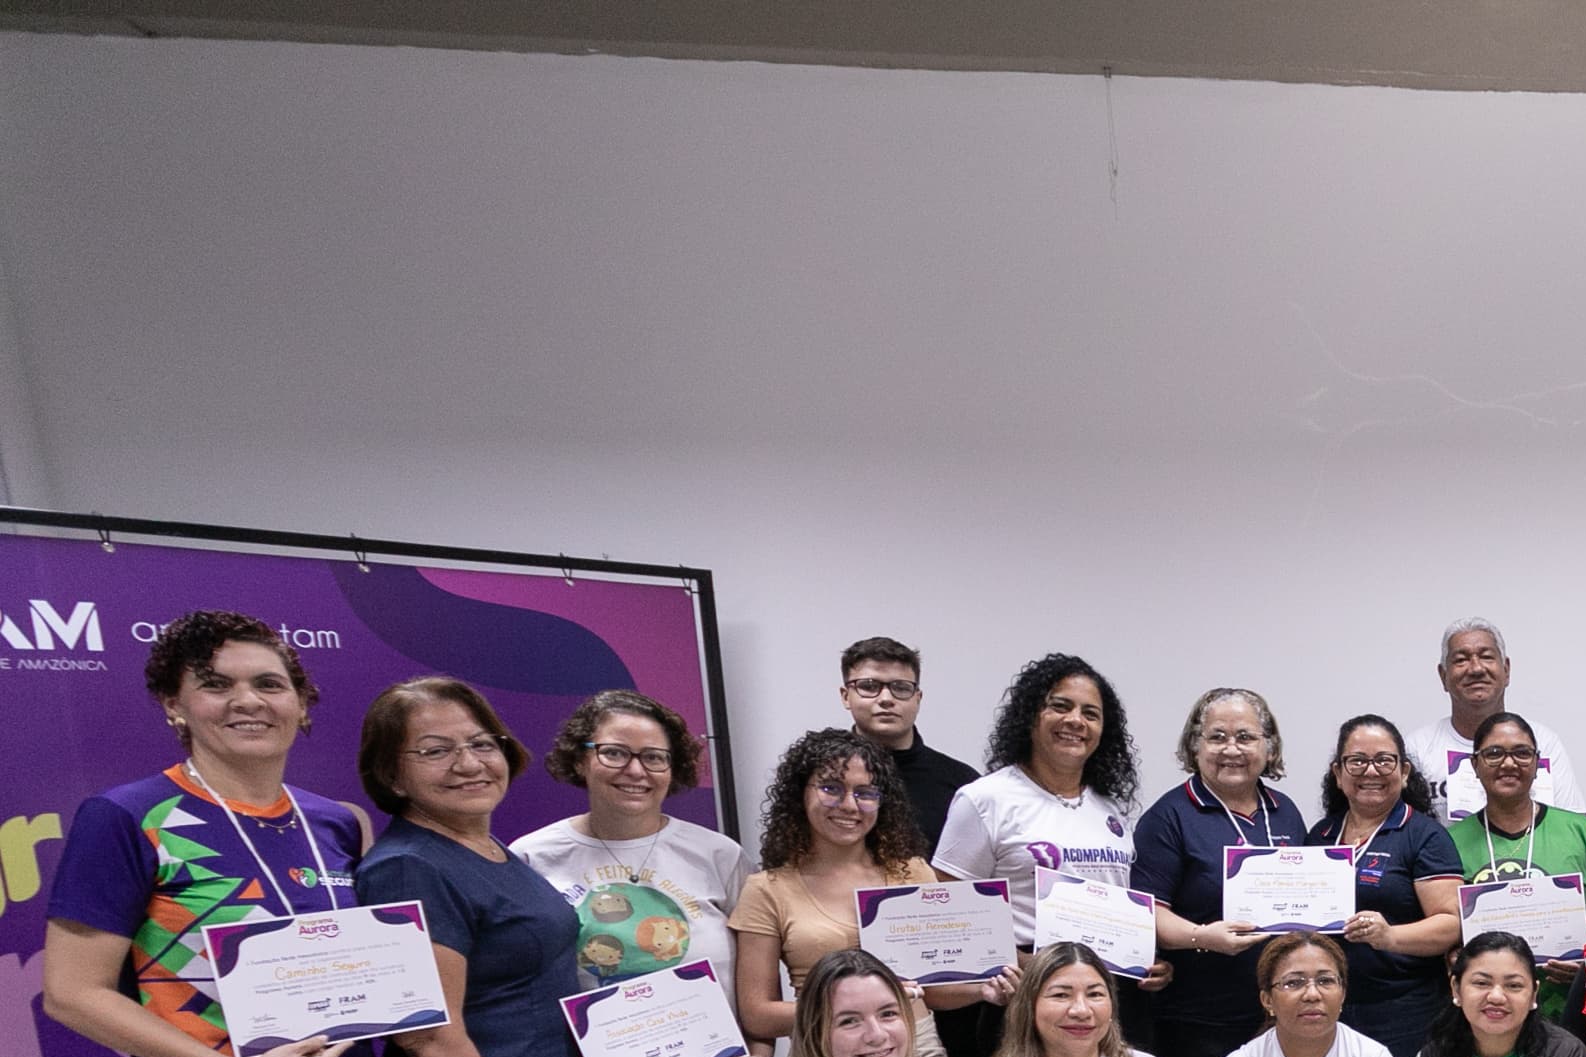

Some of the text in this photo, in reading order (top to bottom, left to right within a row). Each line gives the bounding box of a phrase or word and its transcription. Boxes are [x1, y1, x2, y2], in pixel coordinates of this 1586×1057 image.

[17, 656, 109, 672] AMAZÔNICA
[921, 892, 950, 900] Aurora
[298, 923, 340, 936] Aurora
